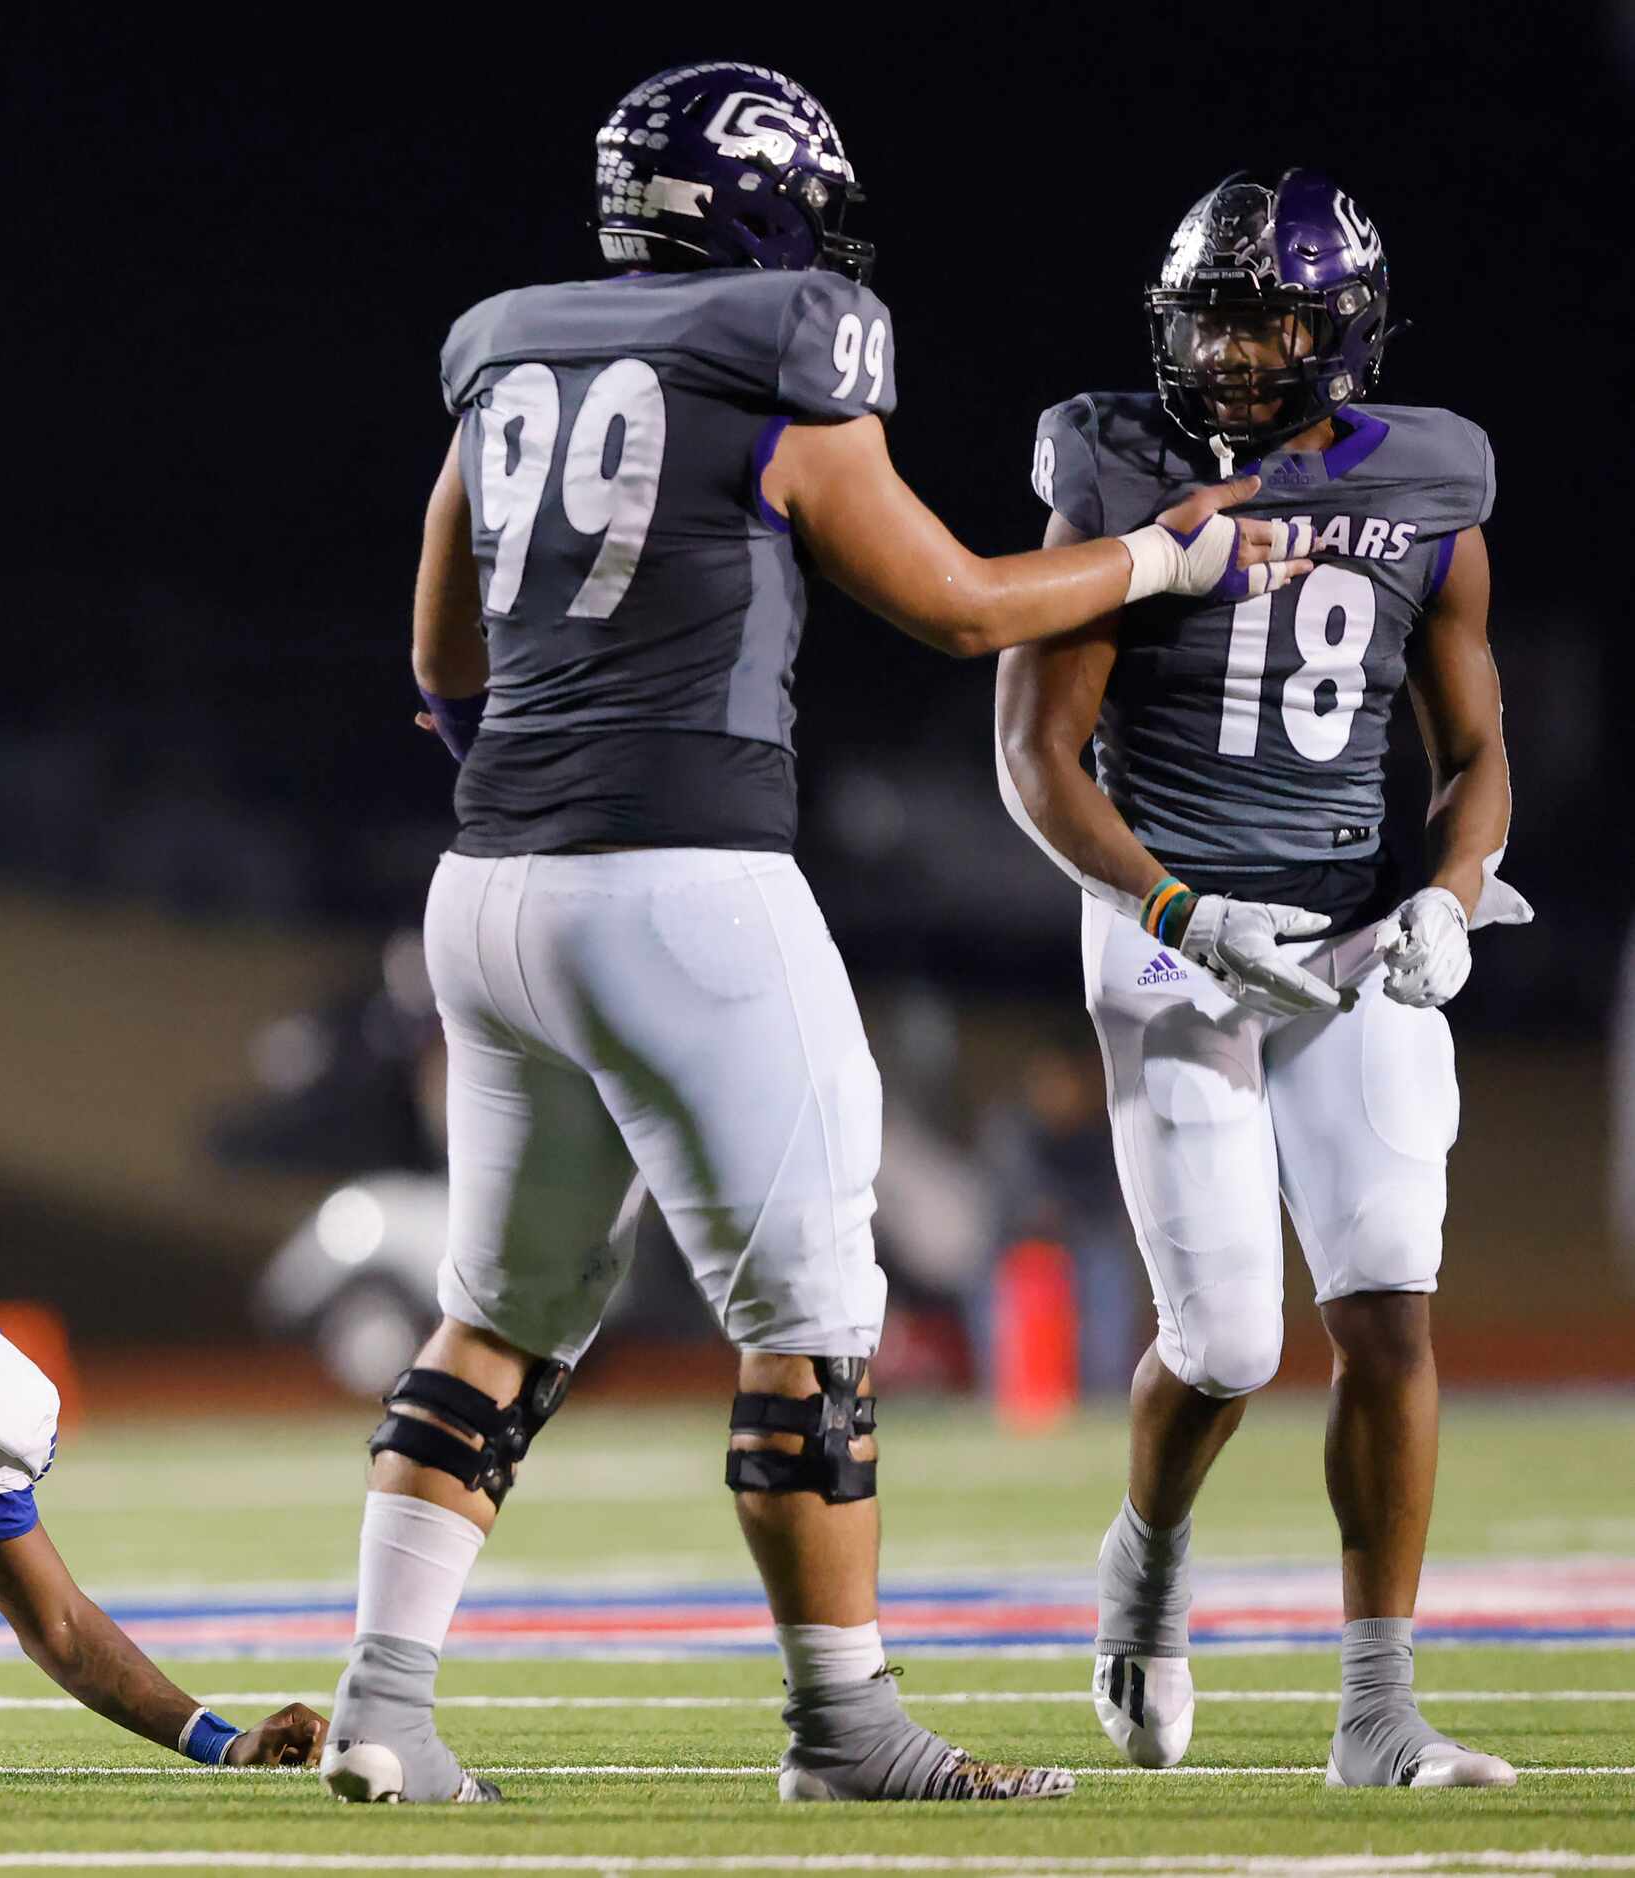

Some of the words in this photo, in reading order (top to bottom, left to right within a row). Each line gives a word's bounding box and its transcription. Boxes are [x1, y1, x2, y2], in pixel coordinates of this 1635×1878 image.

[831, 313, 886, 405] 99
[481, 358, 666, 620] 99
[1218, 563, 1376, 762] 18
[1137, 968, 1188, 986] adidas
